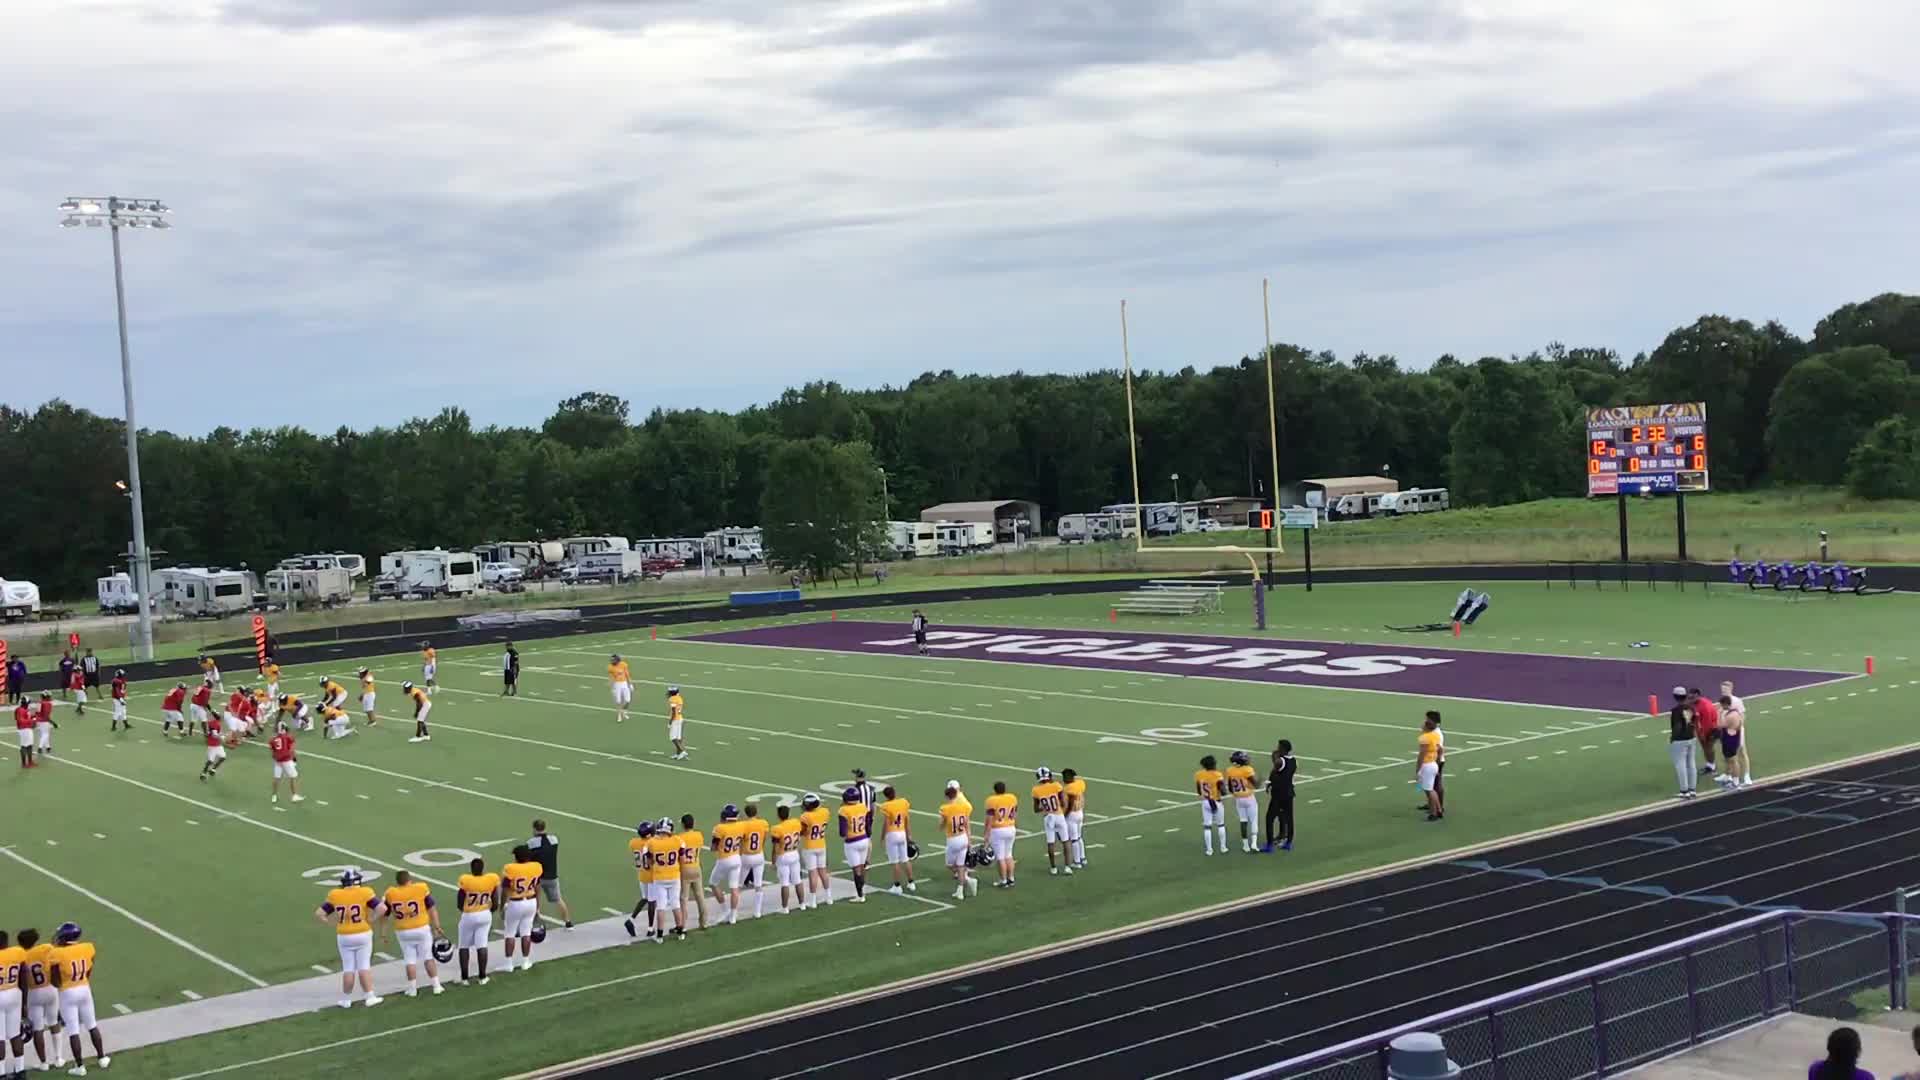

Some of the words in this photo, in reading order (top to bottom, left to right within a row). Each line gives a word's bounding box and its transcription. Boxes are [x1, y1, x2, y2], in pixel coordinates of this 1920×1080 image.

[1643, 416, 1666, 426] HIGH
[1593, 441, 1606, 456] 12
[1694, 436, 1705, 451] 6
[1590, 459, 1600, 474] 0
[1631, 457, 1640, 472] 0
[1694, 454, 1704, 469] 0
[1261, 511, 1271, 530] 0
[862, 631, 1455, 677] TIGERS
[1096, 728, 1209, 746] 10
[748, 832, 760, 852] 8
[335, 903, 363, 925] 72
[30, 962, 47, 987] 6
